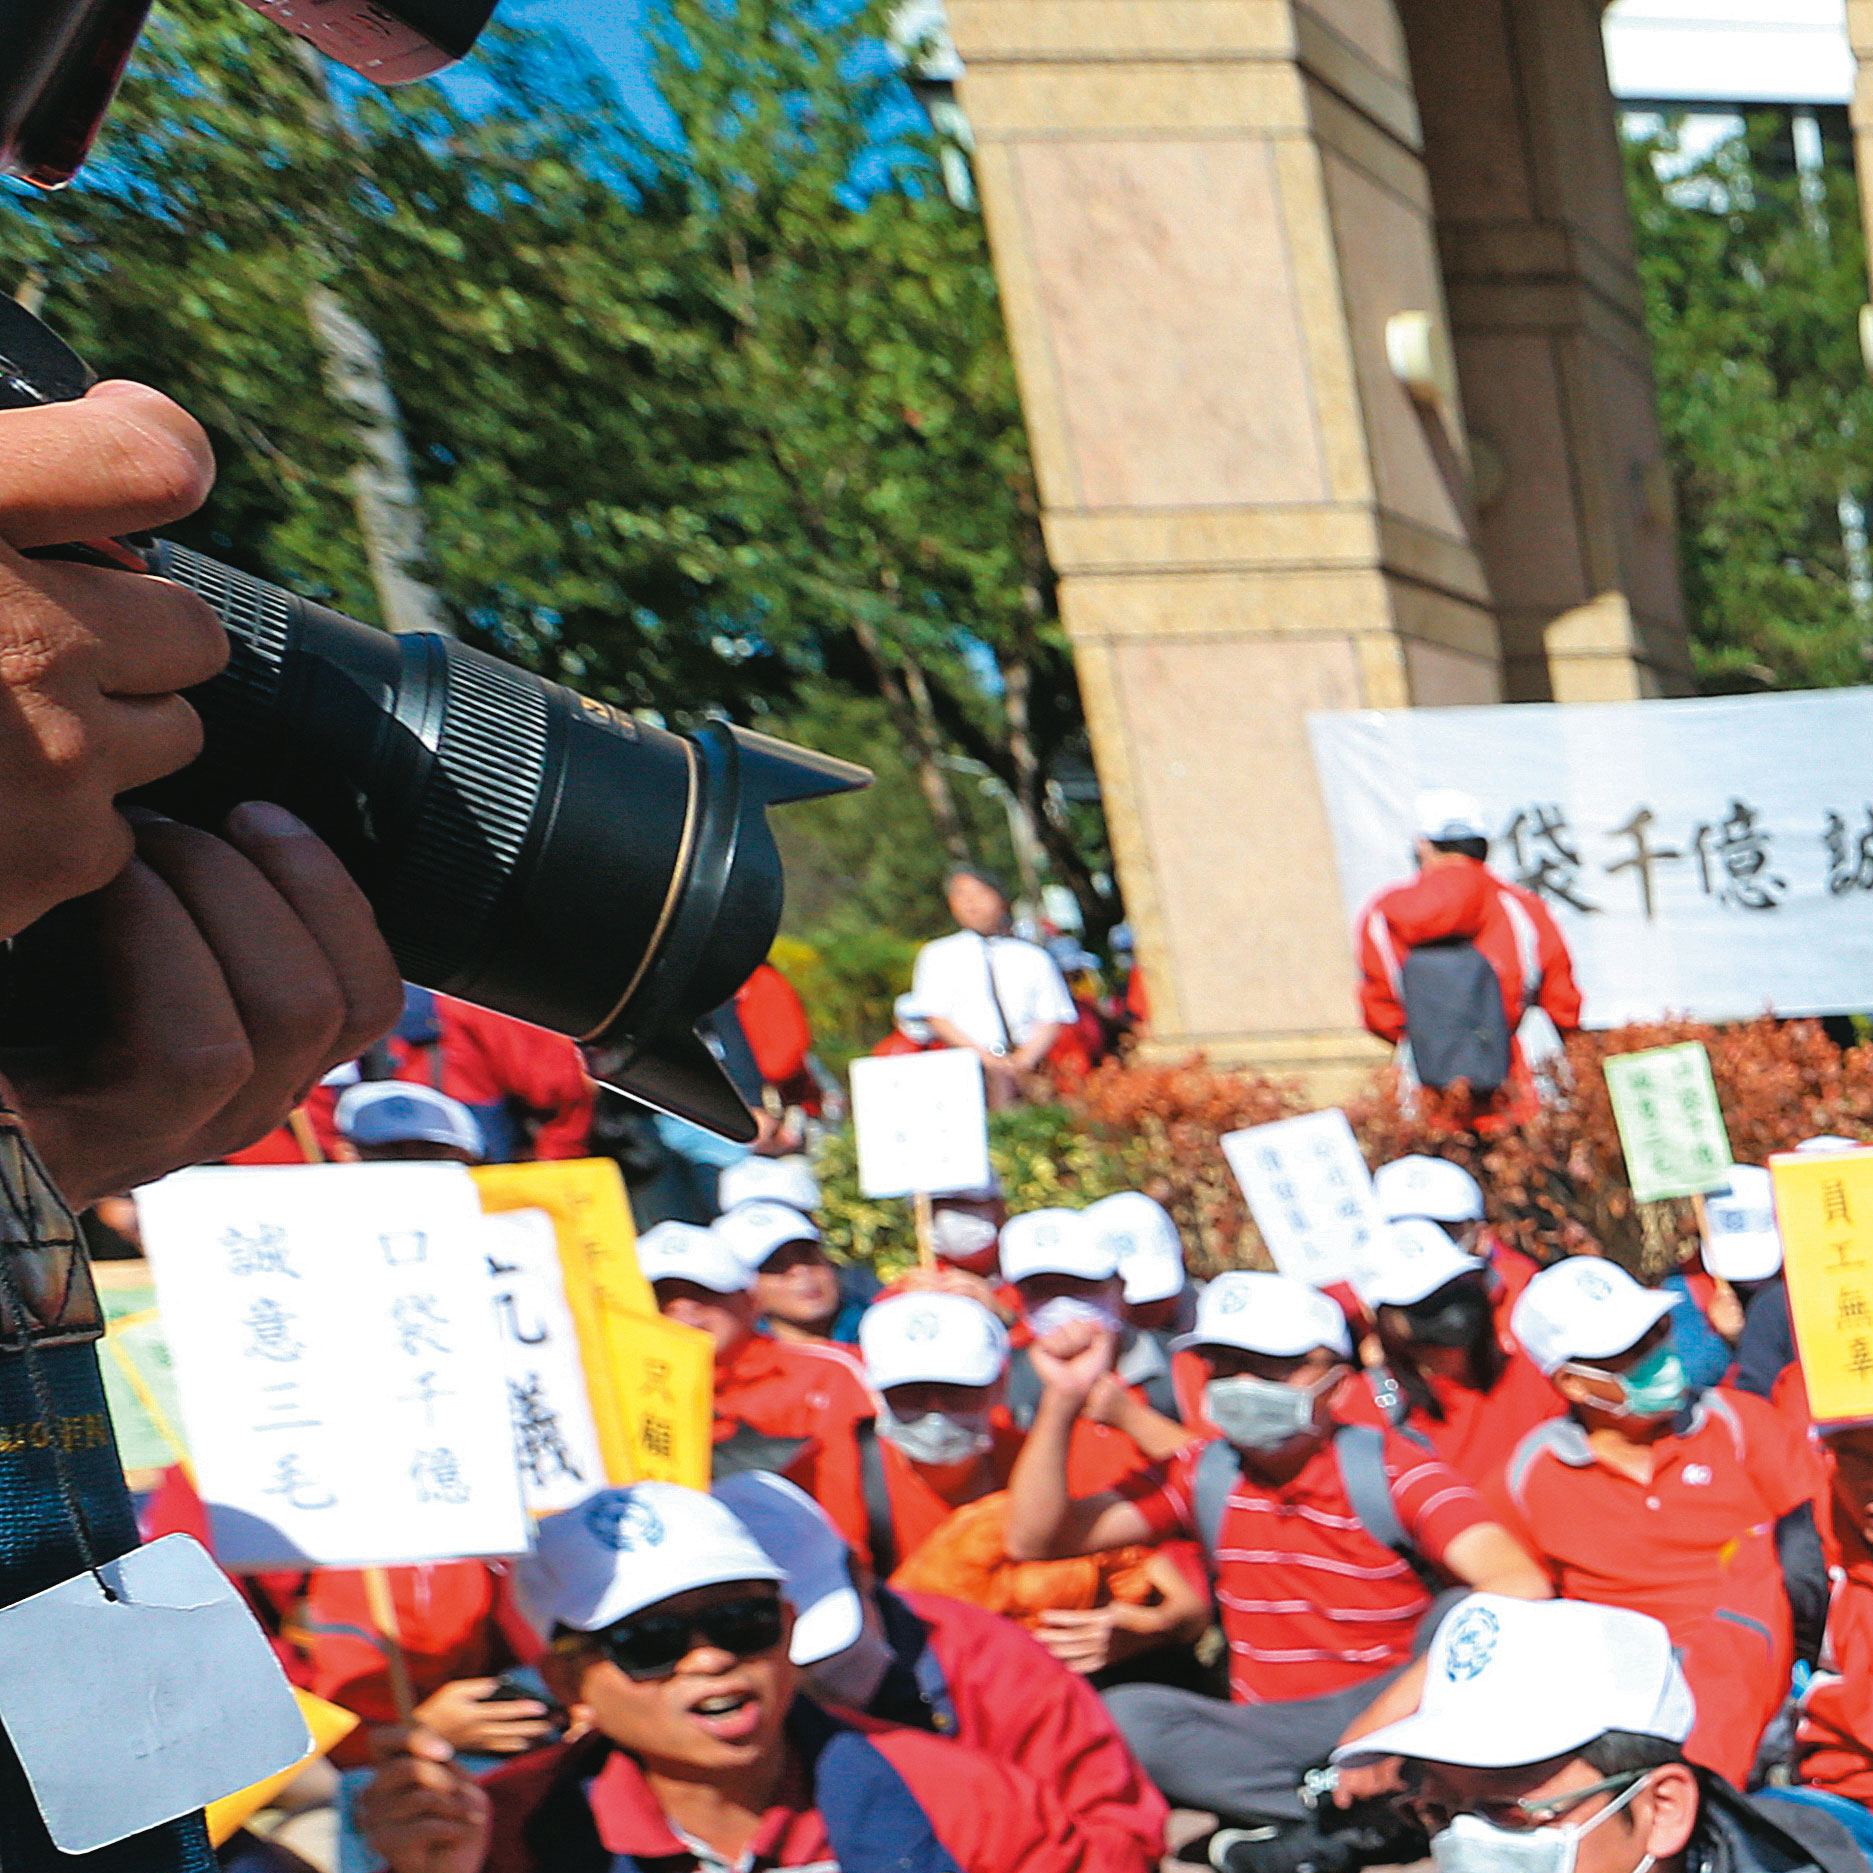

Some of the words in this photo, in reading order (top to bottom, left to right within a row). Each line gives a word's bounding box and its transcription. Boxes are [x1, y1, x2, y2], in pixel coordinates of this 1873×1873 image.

[215, 1220, 339, 1511] 誠意三毛
[378, 1229, 472, 1505] 口袋千億
